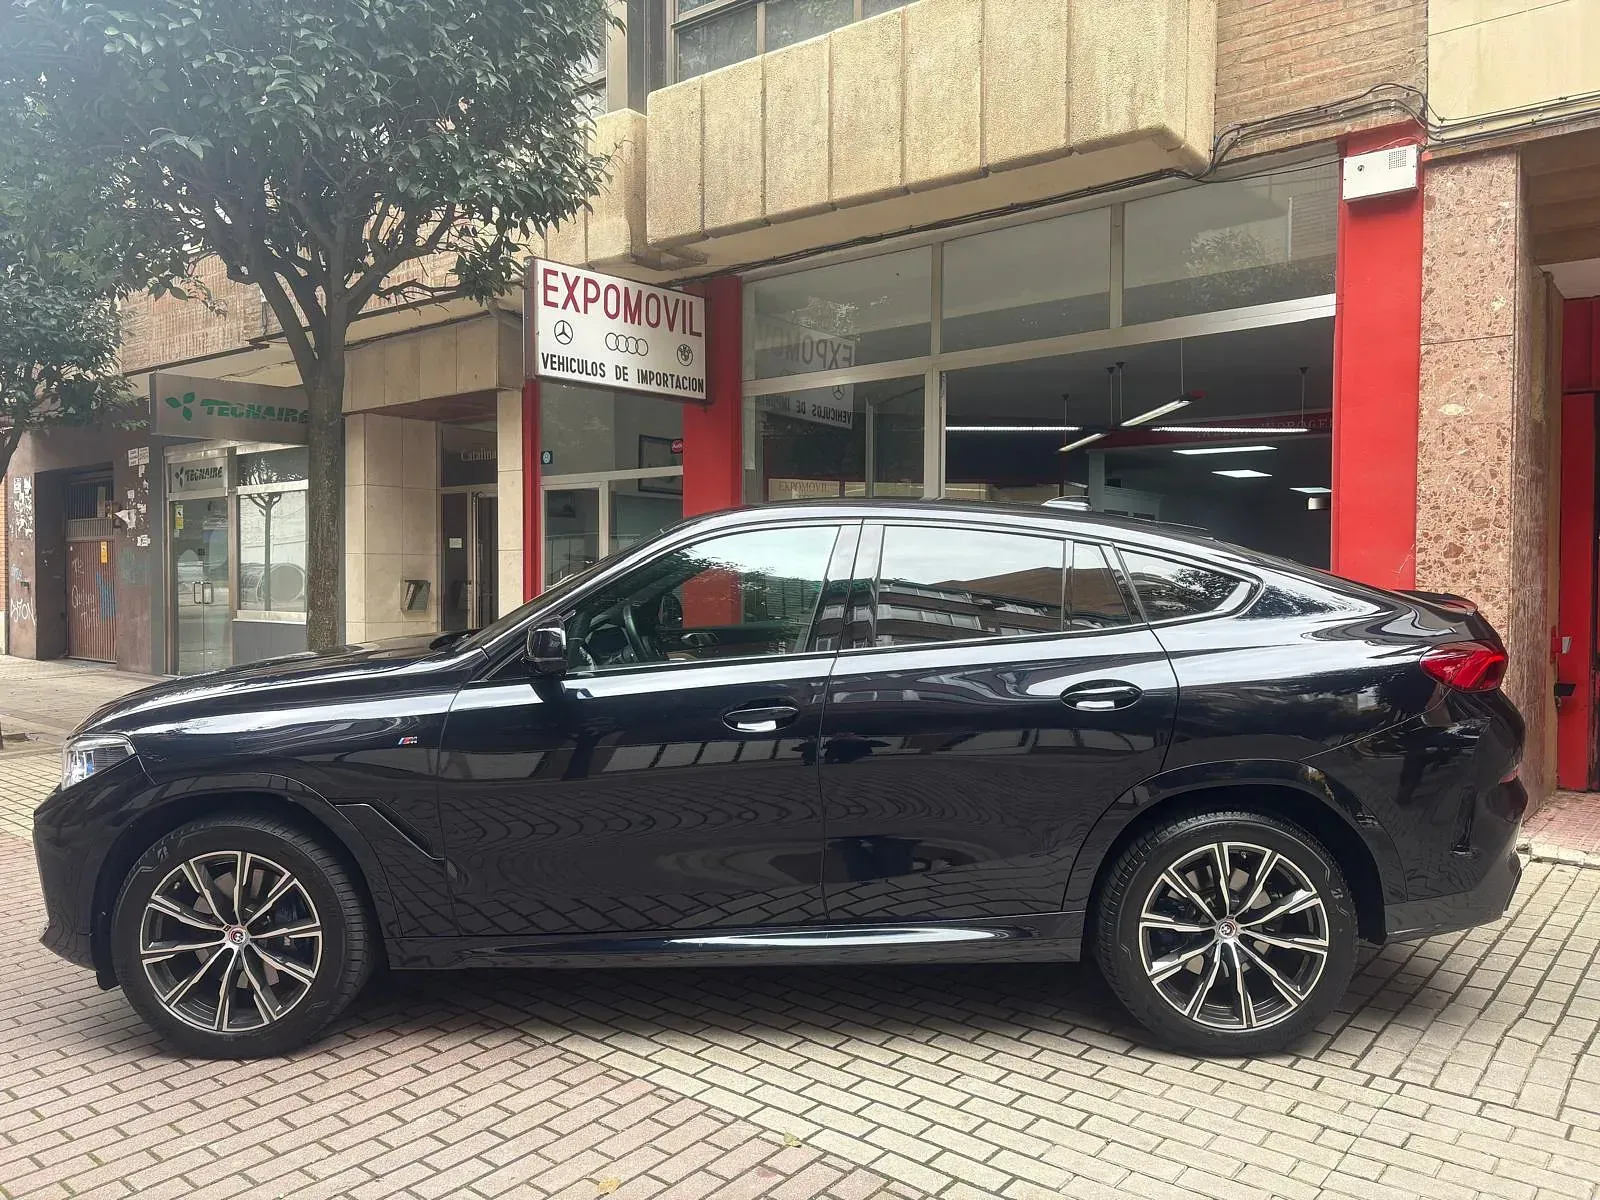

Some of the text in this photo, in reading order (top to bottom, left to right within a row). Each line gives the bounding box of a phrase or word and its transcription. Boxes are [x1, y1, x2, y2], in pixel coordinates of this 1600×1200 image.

[543, 267, 702, 337] EXPOMOVIL
[541, 352, 704, 393] VEHICULOS DE IMPORTACION
